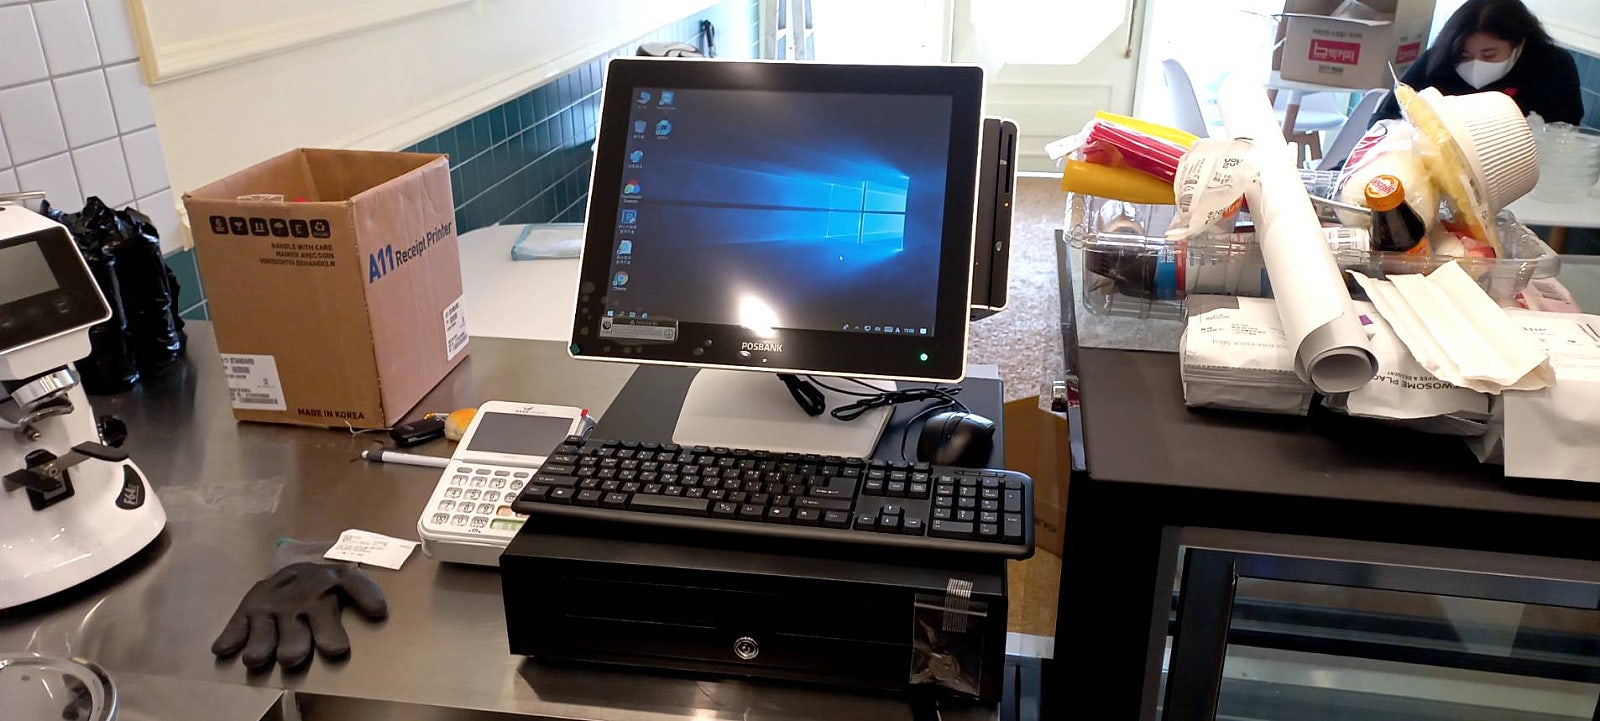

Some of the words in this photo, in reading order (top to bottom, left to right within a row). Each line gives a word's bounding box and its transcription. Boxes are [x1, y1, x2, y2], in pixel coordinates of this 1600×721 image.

[369, 244, 395, 284] A11
[395, 236, 427, 267] Receipt
[426, 222, 452, 247] Printer
[741, 341, 783, 352] POSBANK
[1373, 375, 1399, 385] PLAC
[298, 408, 321, 417] MADE
[334, 411, 365, 419] KOREA
